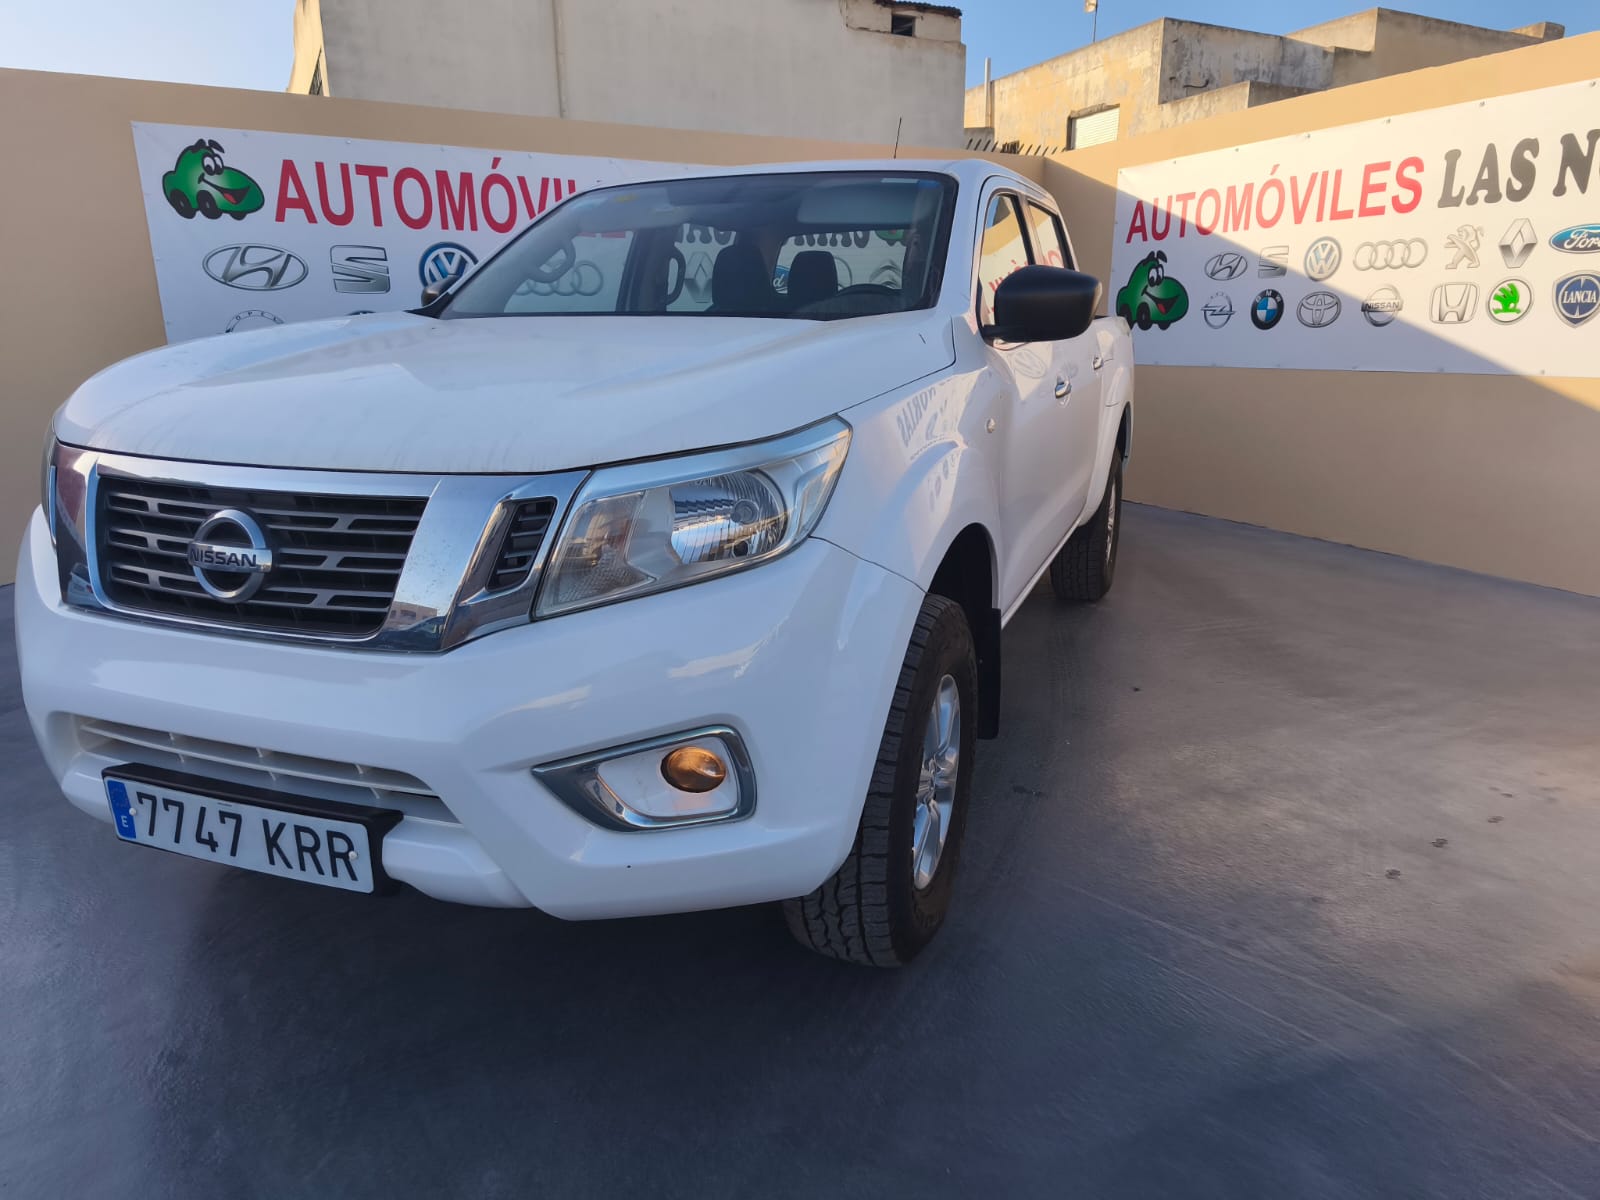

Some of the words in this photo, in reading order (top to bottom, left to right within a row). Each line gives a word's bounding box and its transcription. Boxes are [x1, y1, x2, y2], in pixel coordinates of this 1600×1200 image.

[274, 157, 577, 234] AUTOMÓV
[1126, 156, 1425, 244] AUTOMÓVILES
[1437, 137, 1540, 208] LAS
[1552, 128, 1600, 197] N
[1563, 228, 1600, 250] For
[1365, 301, 1400, 310] NISSAN
[1562, 290, 1597, 304] LANCIA
[189, 547, 257, 568] NISSAN
[120, 815, 129, 828] E
[135, 791, 243, 857] 7747
[261, 818, 359, 882] KRR
